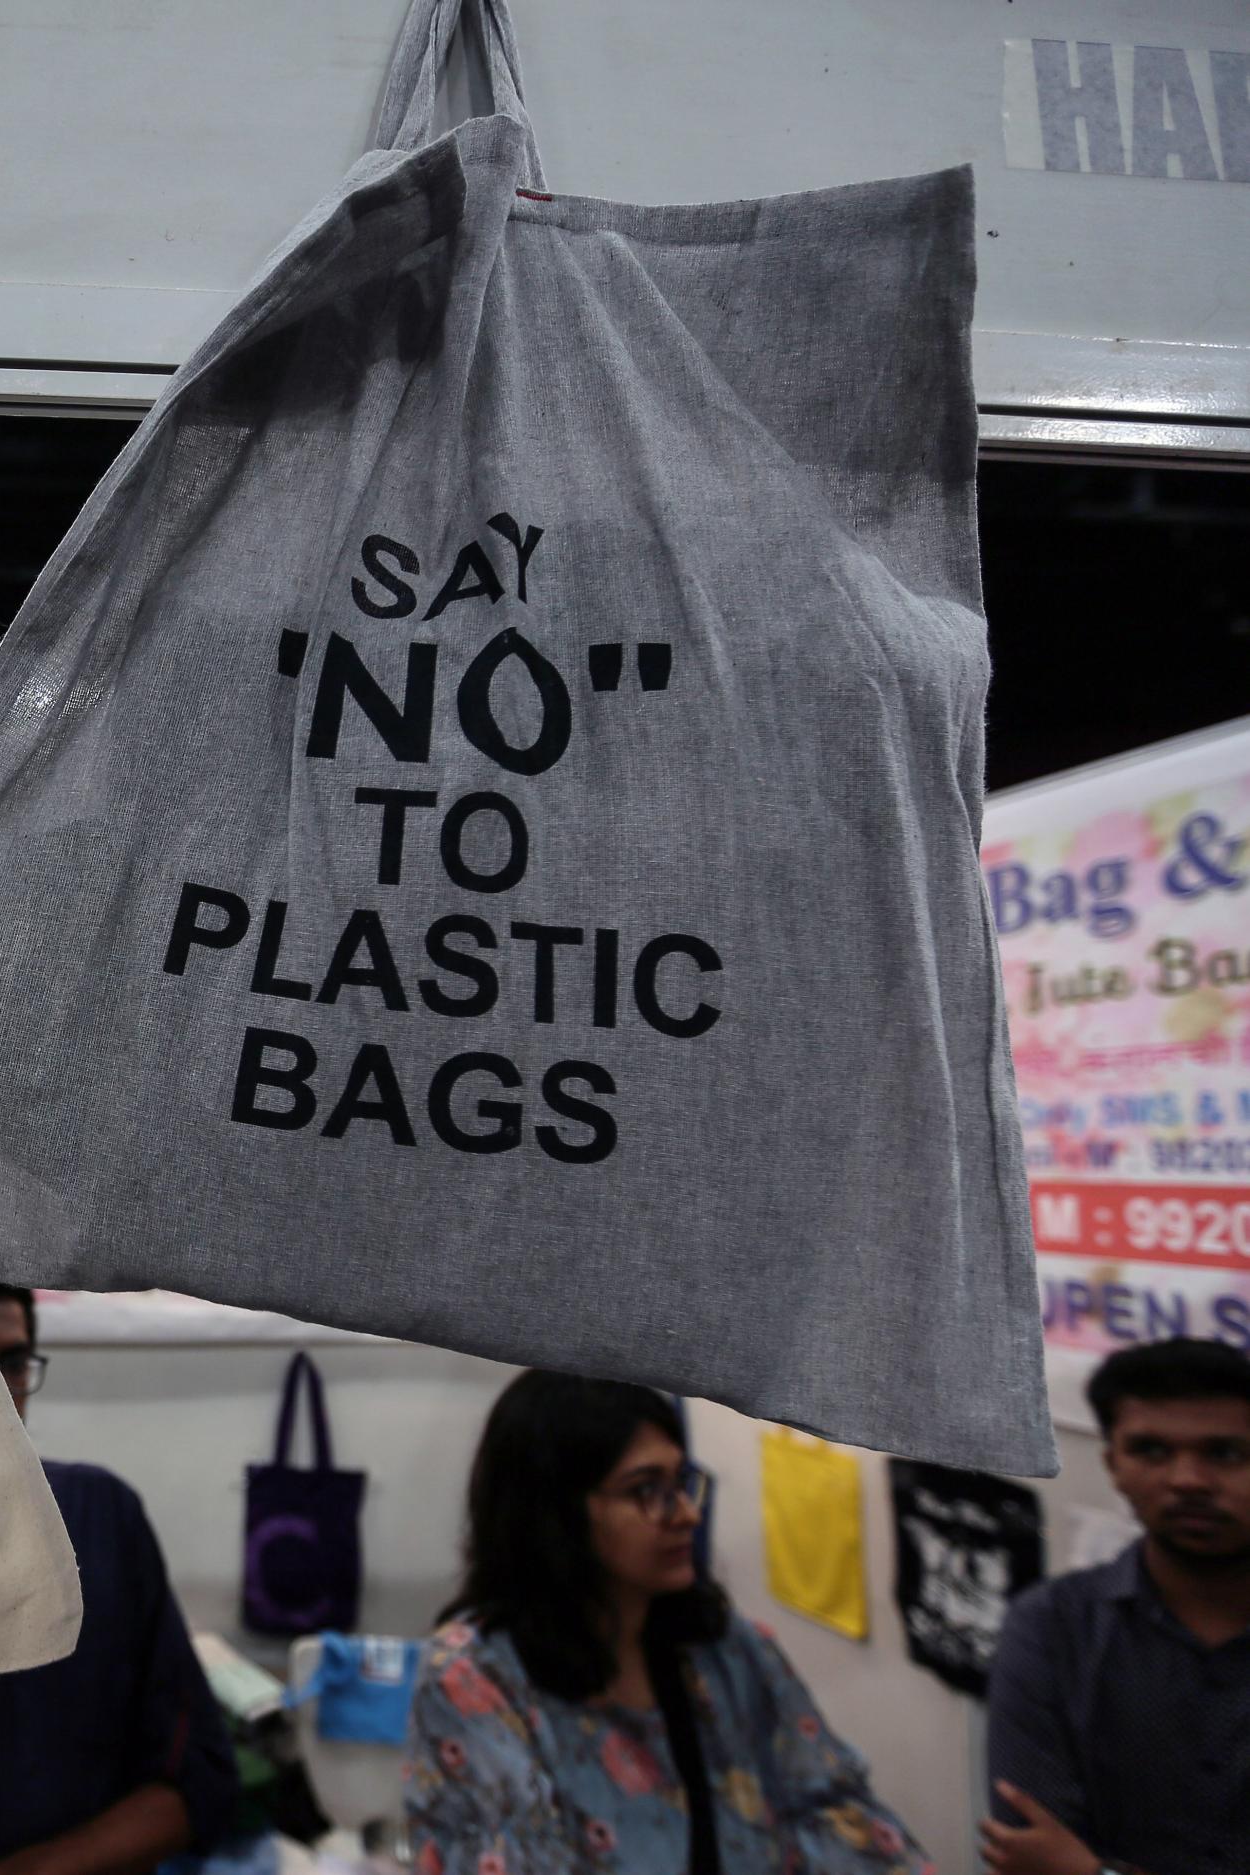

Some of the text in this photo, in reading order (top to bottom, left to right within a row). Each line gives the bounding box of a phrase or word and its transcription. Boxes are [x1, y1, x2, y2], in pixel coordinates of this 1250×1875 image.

[351, 512, 544, 621] SAY
[354, 787, 529, 893] TO
[1162, 812, 1246, 900] &
[163, 882, 723, 1038] PLASTIC
[231, 1026, 618, 1164] BAGS
